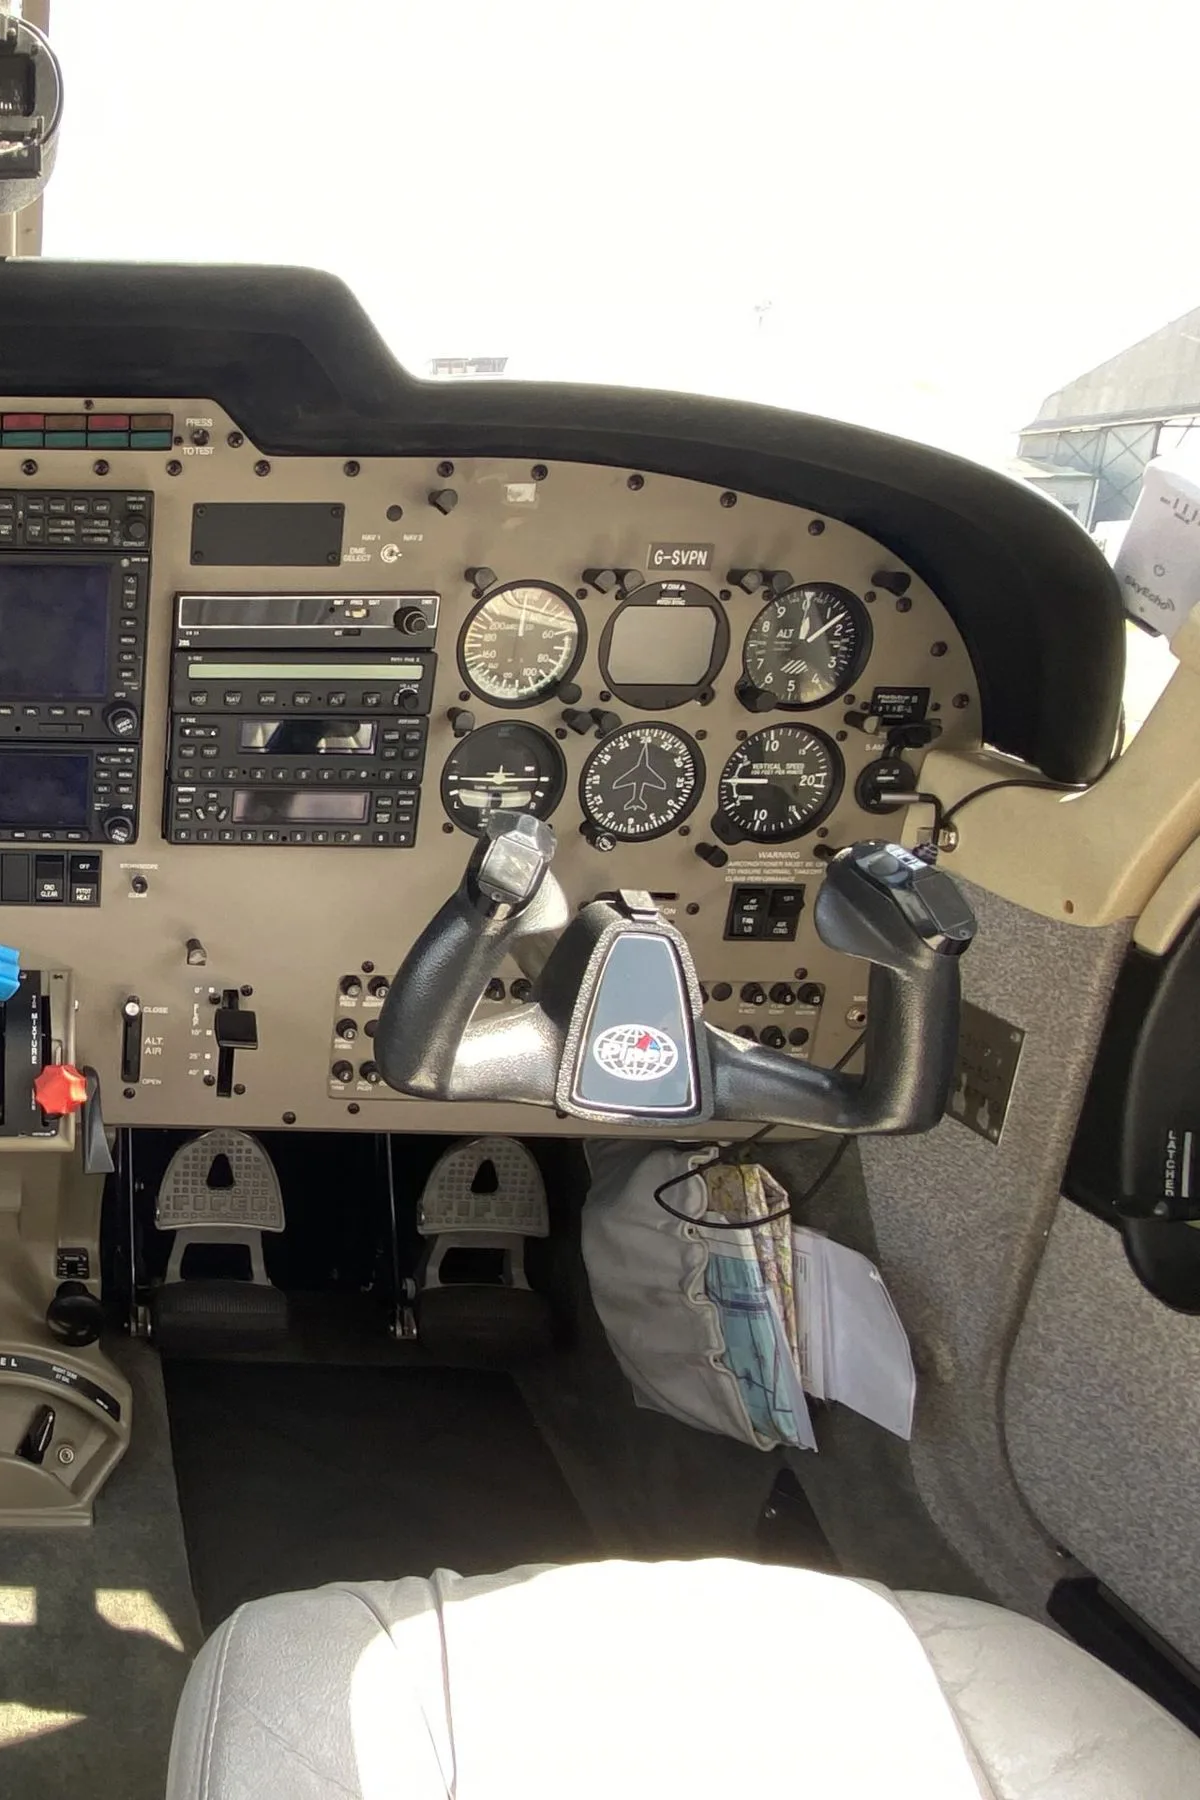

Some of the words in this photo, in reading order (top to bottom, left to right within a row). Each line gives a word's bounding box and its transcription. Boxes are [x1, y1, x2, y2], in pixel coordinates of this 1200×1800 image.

[186, 418, 212, 426] PRESS
[183, 447, 194, 455] TO
[196, 446, 214, 455] TEST
[654, 550, 708, 566] G-SVPN
[777, 606, 786, 618] 9
[762, 621, 770, 632] 8
[834, 624, 843, 636] 2
[542, 630, 554, 639] 60
[776, 628, 794, 638] ALT
[482, 650, 496, 658] 160
[538, 654, 550, 662] 80
[757, 658, 764, 670] 7
[828, 656, 836, 668] 3
[523, 668, 537, 676] 100
[764, 672, 773, 684] 6
[812, 673, 820, 684] 4
[787, 680, 796, 692] 5
[661, 742, 672, 752] 27
[765, 740, 780, 752] 10
[800, 774, 816, 786] 20
[454, 801, 460, 809] L
[754, 809, 768, 820] 10
[144, 1037, 164, 1046] ALT.
[144, 1047, 162, 1055] AIR
[1165, 1130, 1177, 1196] LATCHED
[173, 1195, 268, 1212] PIPER
